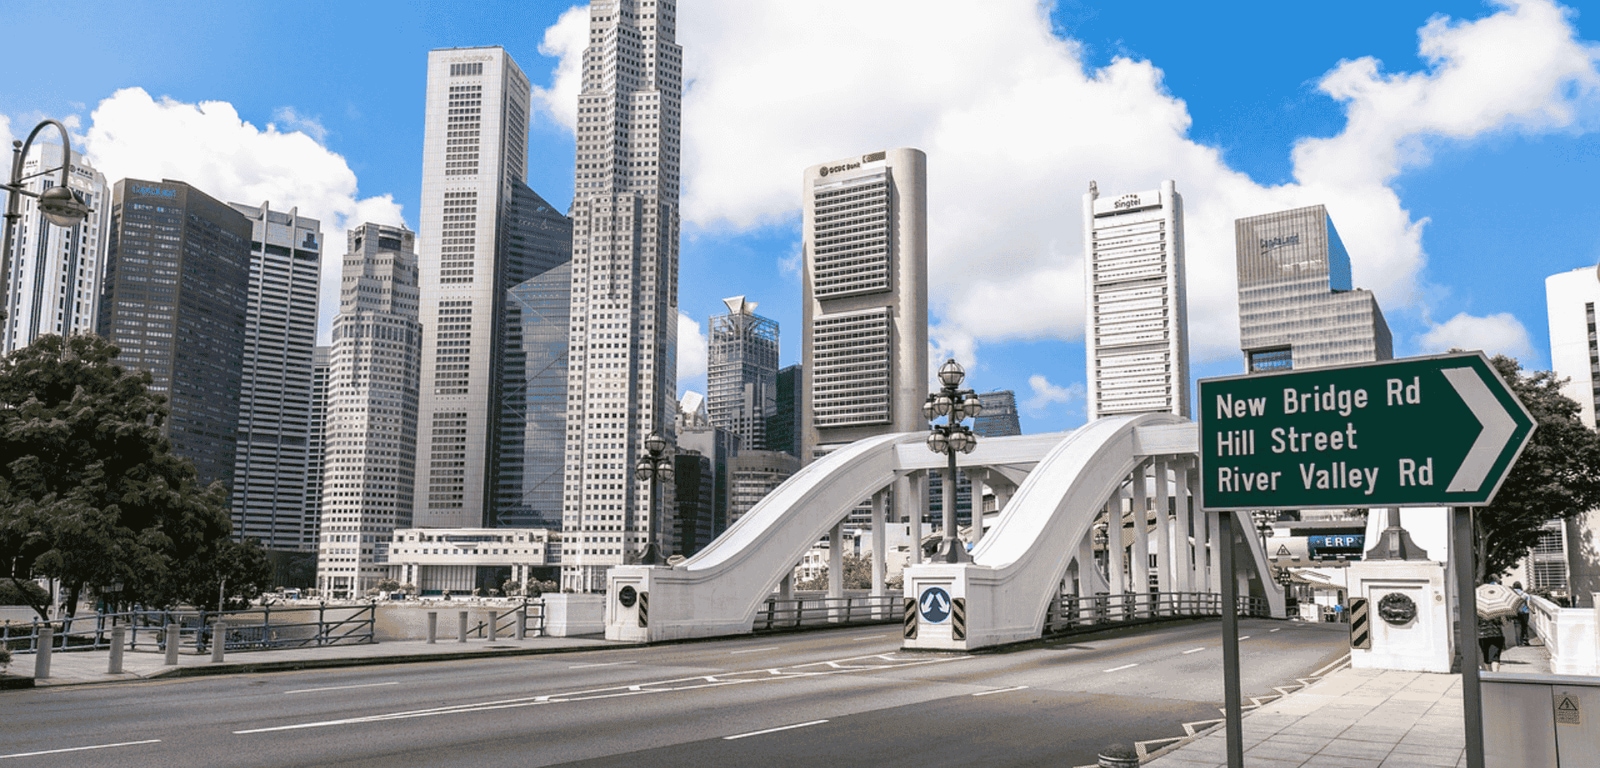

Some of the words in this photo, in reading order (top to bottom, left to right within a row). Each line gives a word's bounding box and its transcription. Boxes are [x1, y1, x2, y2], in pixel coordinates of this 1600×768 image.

[1114, 198, 1141, 210] Singtel
[1216, 393, 1267, 420] New
[1283, 384, 1369, 416] Bridge
[1385, 376, 1421, 406] Rd
[1217, 429, 1255, 457] Hill
[1271, 422, 1358, 454] Street
[1218, 466, 1282, 492] River
[1299, 462, 1379, 495] Valley
[1399, 457, 1434, 487] Rd
[1325, 537, 1354, 547] ERP
